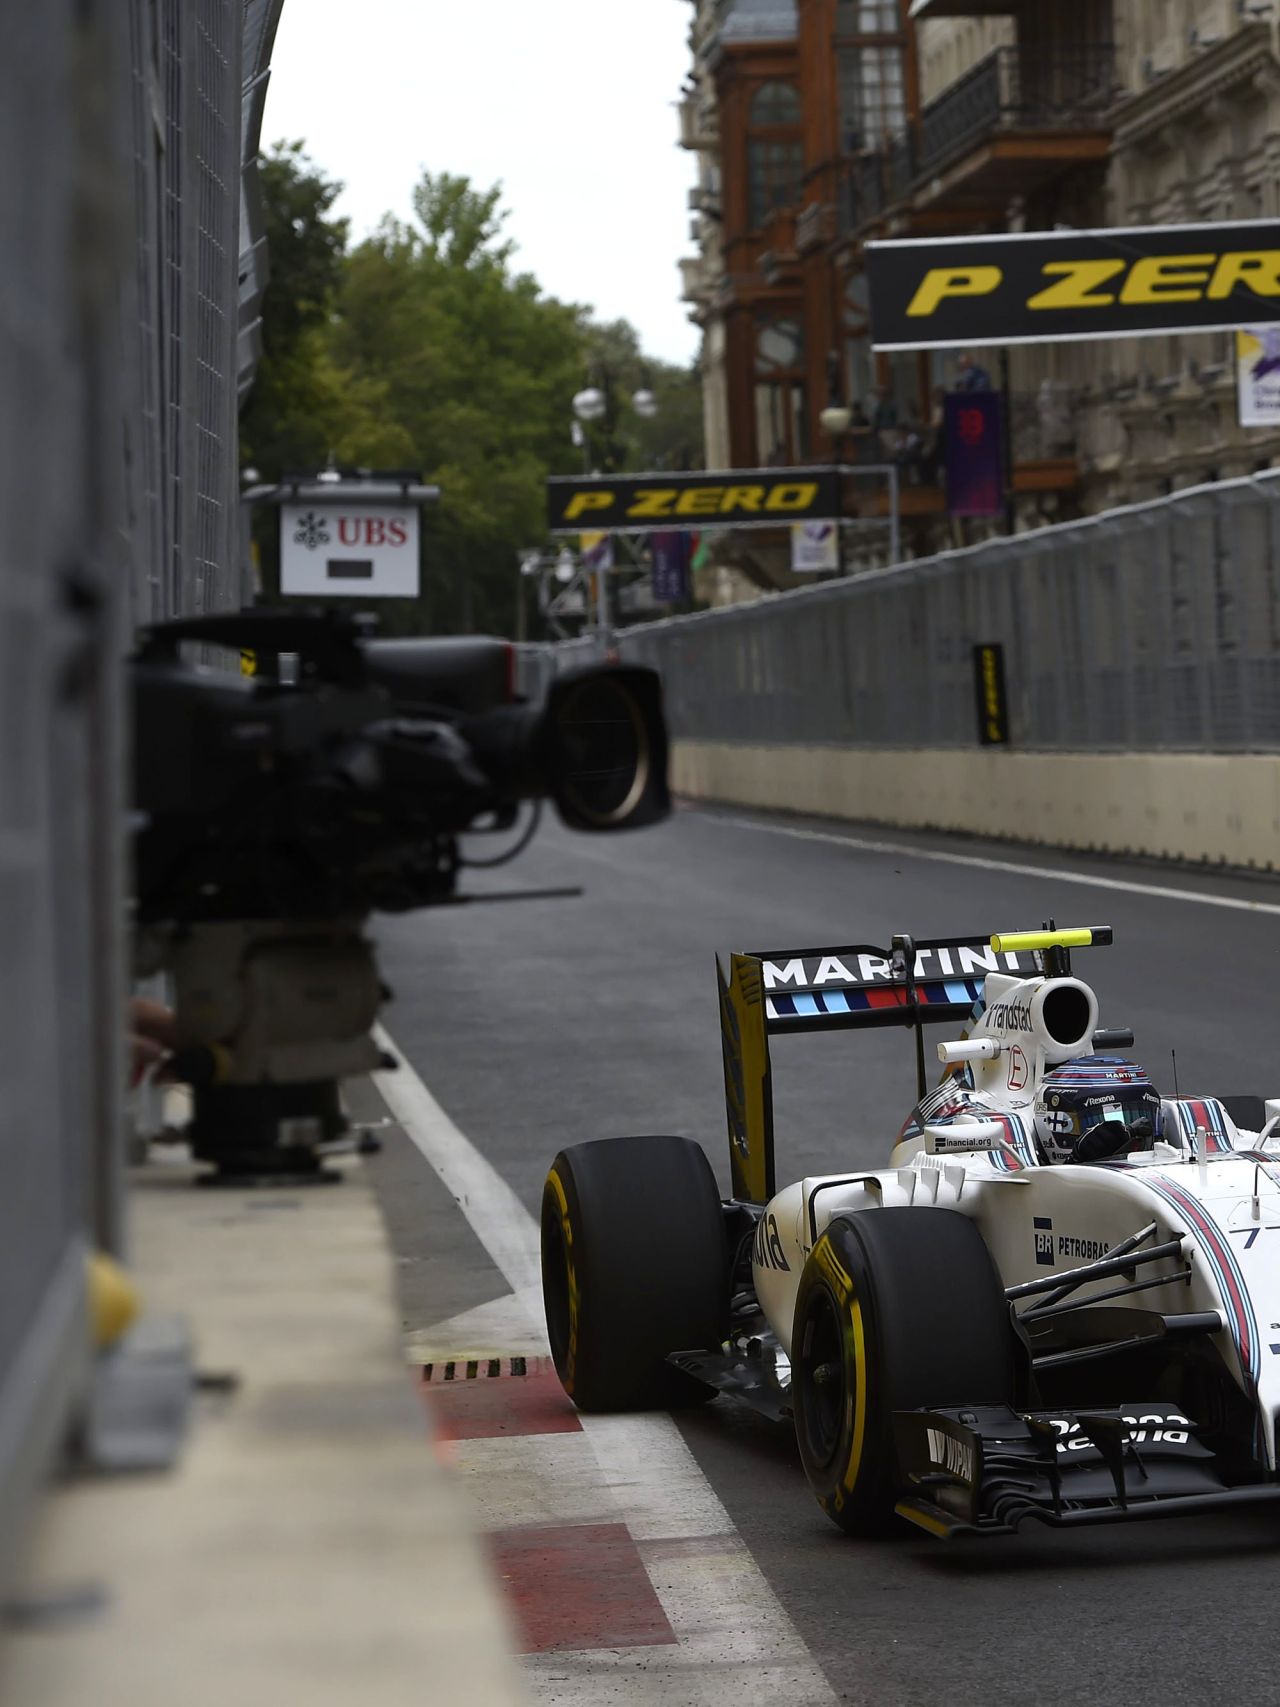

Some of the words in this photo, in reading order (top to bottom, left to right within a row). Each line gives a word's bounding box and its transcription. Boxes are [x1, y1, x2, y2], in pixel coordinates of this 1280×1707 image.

[905, 265, 1003, 317] P
[563, 491, 616, 519] P
[625, 482, 819, 517] ZERO
[337, 516, 408, 547] UBS
[763, 945, 1020, 988] MARTINI
[993, 996, 1034, 1033] randstad
[1105, 1072, 1138, 1080] MARTINI
[1089, 1094, 1115, 1106] Rexona
